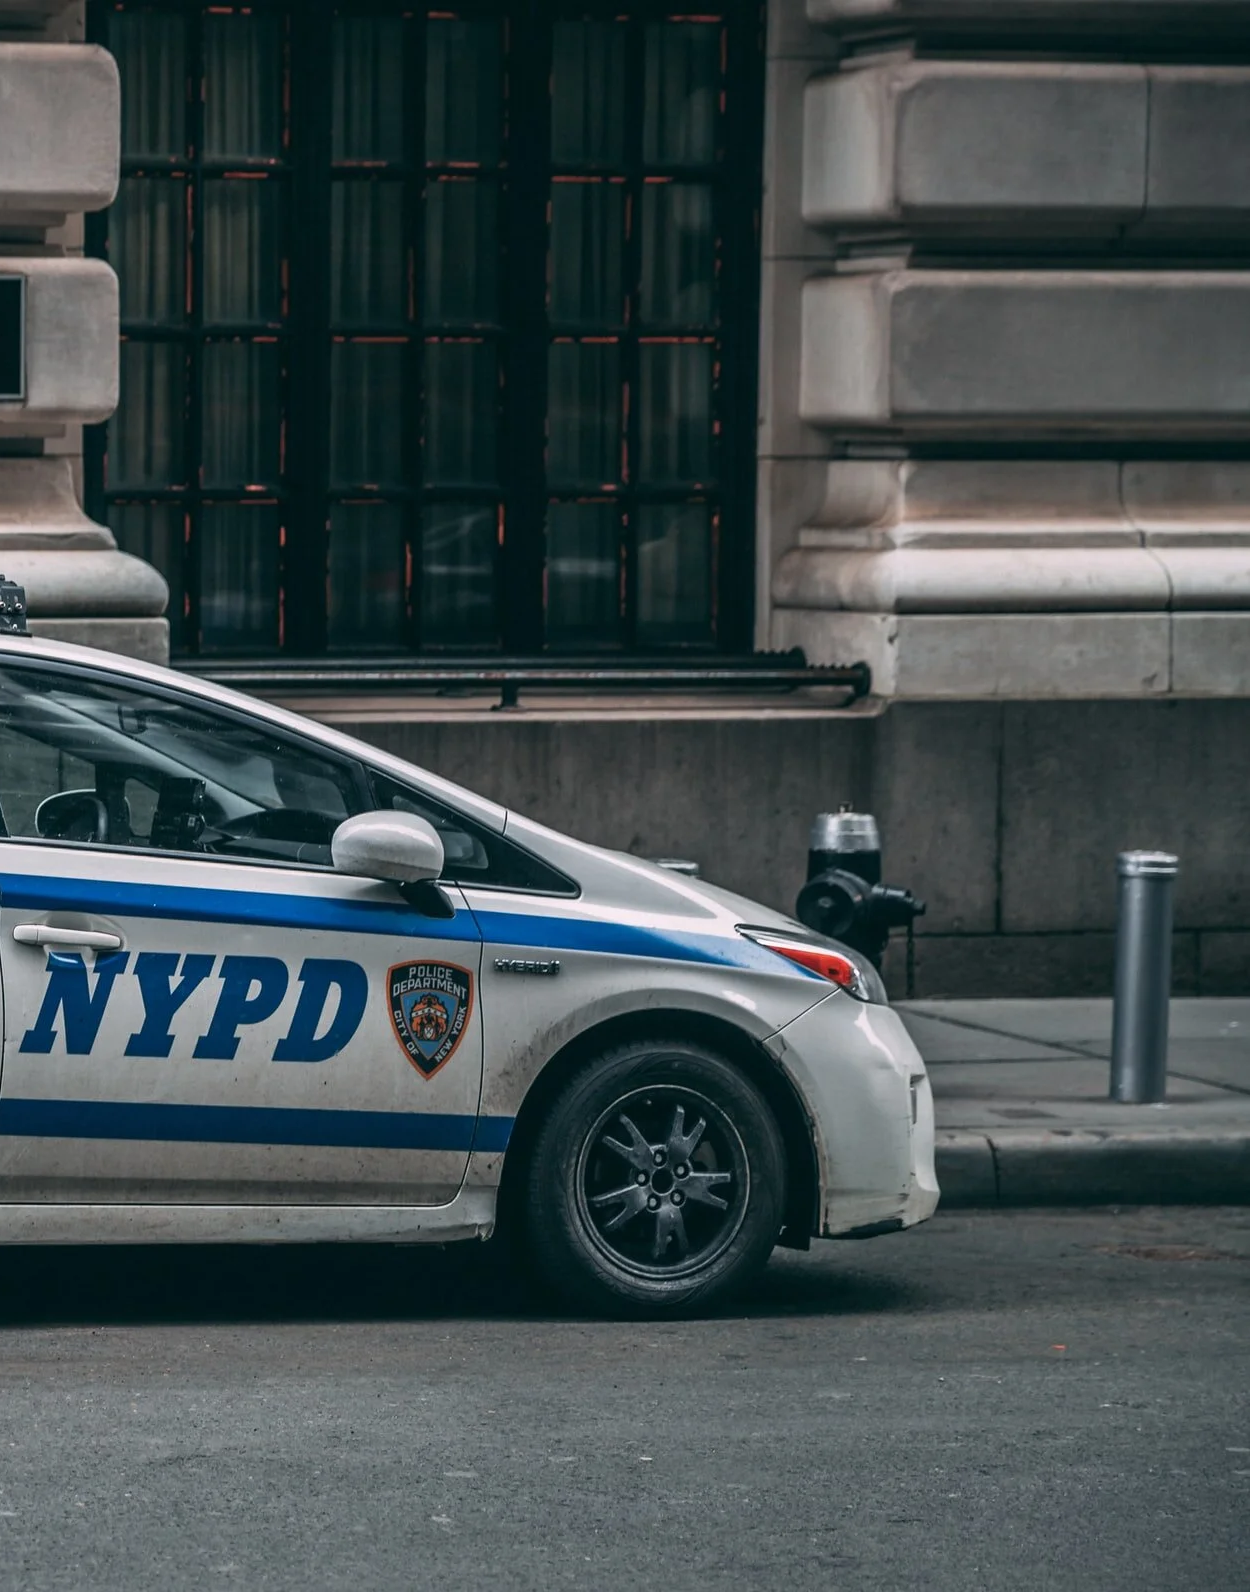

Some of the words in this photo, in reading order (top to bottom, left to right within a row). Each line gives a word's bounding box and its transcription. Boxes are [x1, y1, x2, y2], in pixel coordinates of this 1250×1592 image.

[393, 977, 467, 1000] DEPARTMENT
[409, 966, 453, 979] POLICE
[18, 951, 368, 1063] NYPD
[394, 1010, 408, 1037] CITY
[406, 1043, 419, 1056] OF
[434, 1042, 453, 1063] NEW
[451, 1006, 467, 1035] YORK
